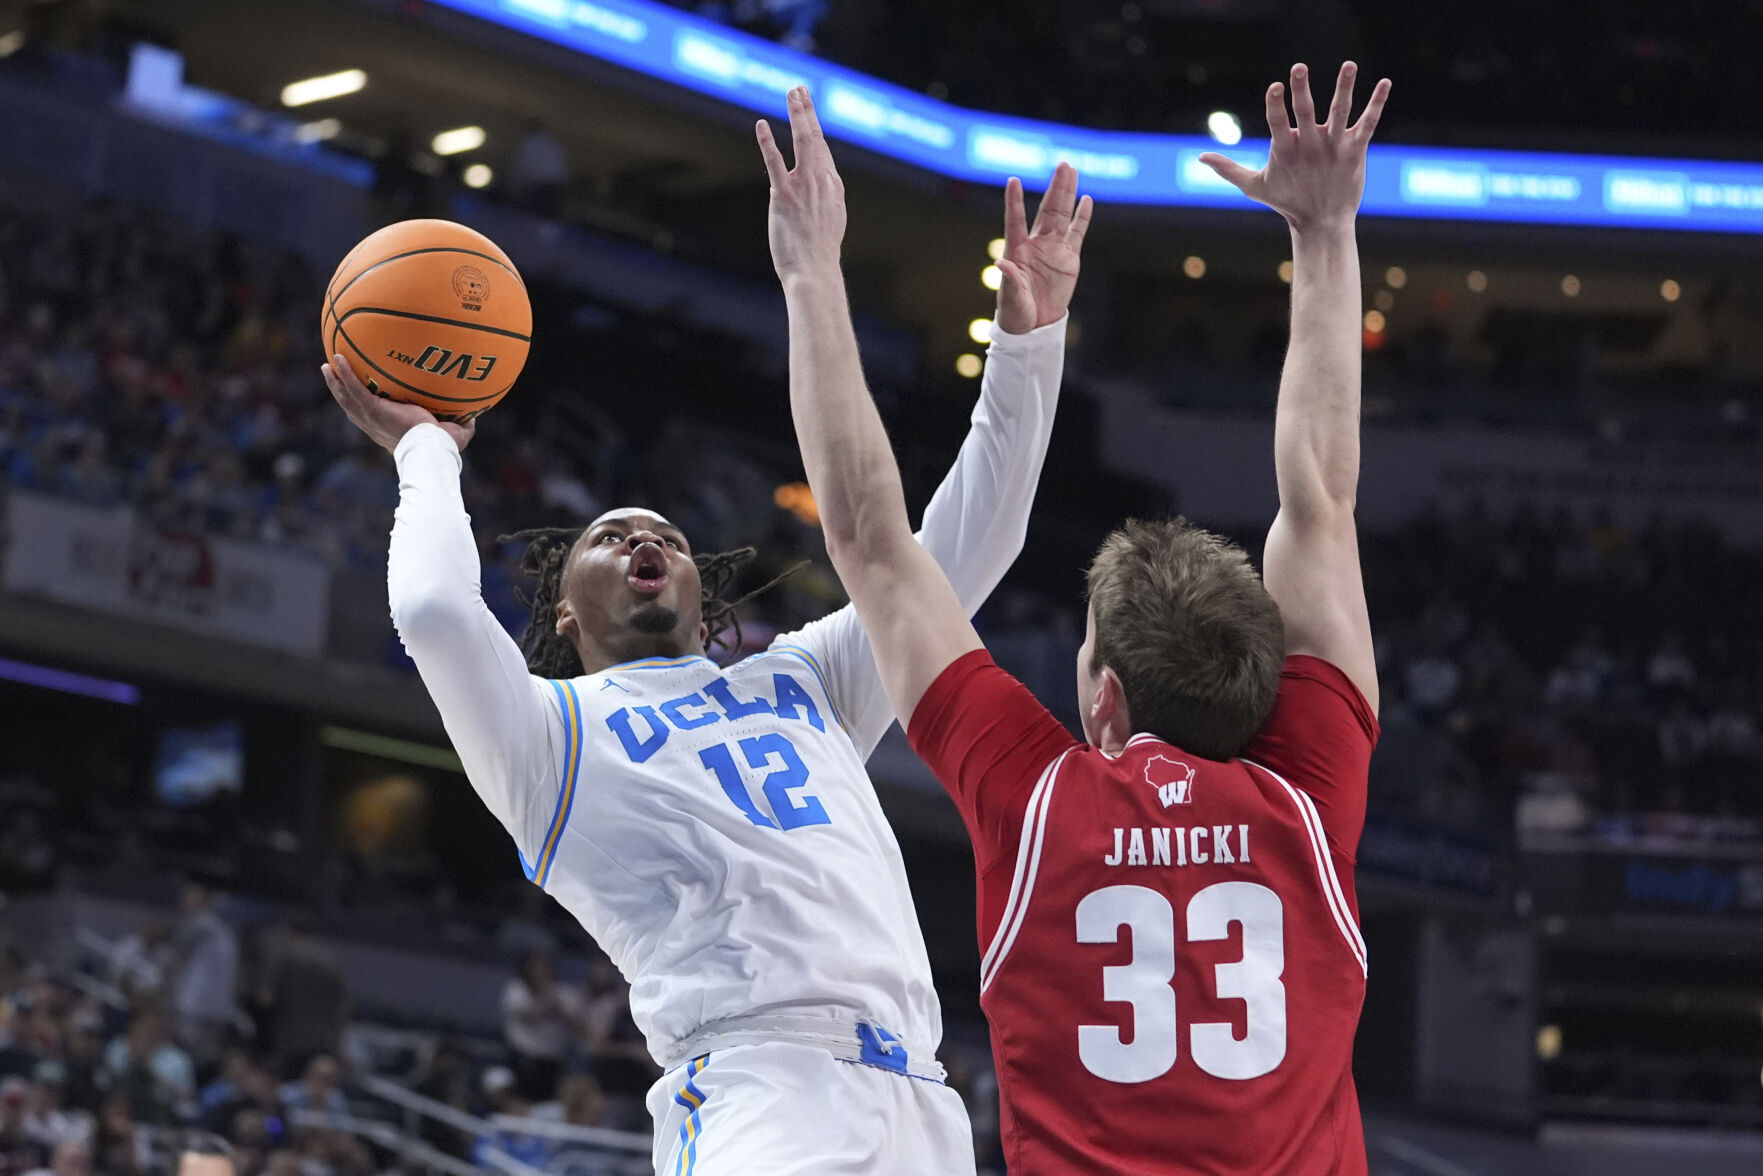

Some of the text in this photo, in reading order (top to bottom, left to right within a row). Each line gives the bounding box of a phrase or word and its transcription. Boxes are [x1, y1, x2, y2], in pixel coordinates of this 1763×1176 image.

[386, 345, 497, 381] EVO NXT
[605, 673, 826, 763] UCLA
[697, 733, 832, 831] 12
[1158, 780, 1188, 808] W
[1104, 824, 1251, 866] JANICKI
[1075, 881, 1287, 1083] 33
